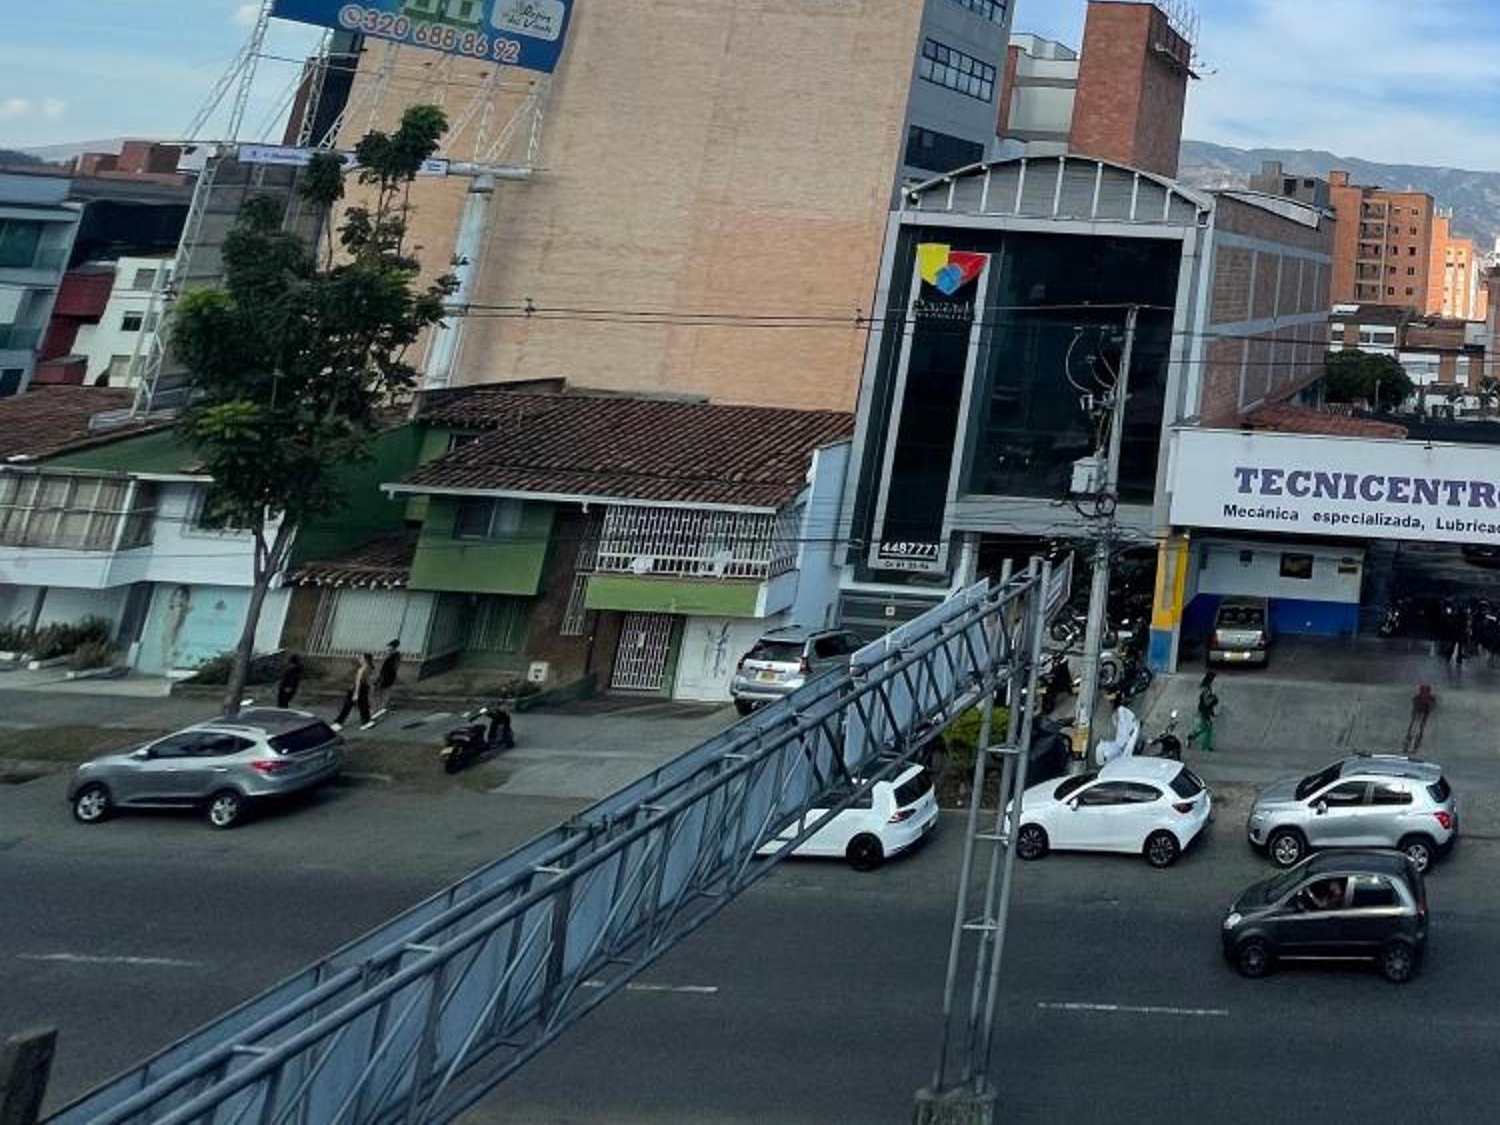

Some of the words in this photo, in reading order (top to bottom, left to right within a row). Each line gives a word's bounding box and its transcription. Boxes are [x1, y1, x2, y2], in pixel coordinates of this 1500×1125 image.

[362, 9, 410, 39] 320
[415, 22, 456, 49] 688
[459, 31, 489, 57] 86
[493, 39, 521, 63] 92
[1223, 504, 1299, 522] Mecánica
[1312, 511, 1426, 531] especializada,
